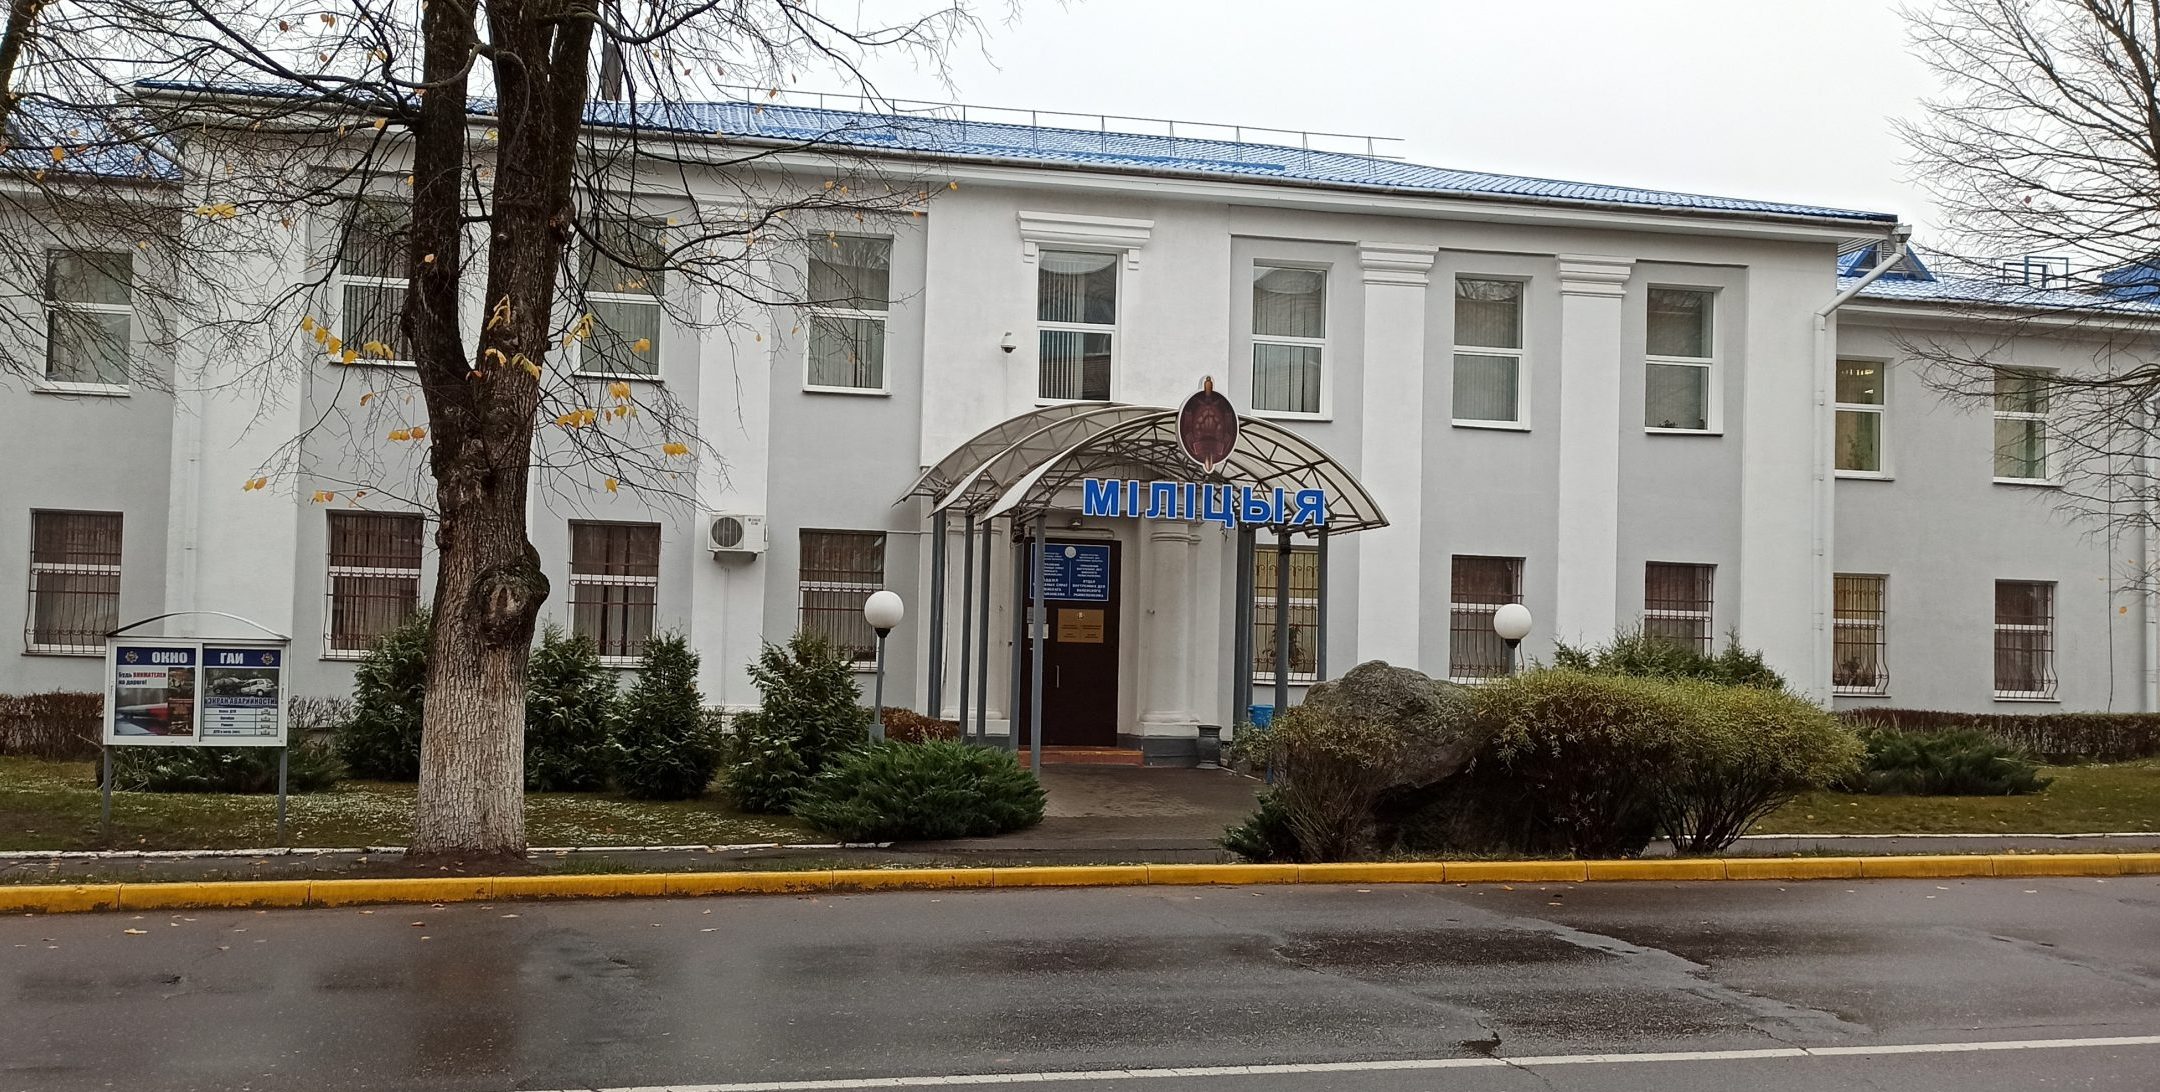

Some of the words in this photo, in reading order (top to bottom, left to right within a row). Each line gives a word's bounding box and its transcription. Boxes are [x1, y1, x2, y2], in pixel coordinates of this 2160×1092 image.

[1083, 478, 1325, 528] МІЛІЦЫЯ
[151, 651, 188, 664] ОКНО
[220, 652, 244, 664] ГАИ
